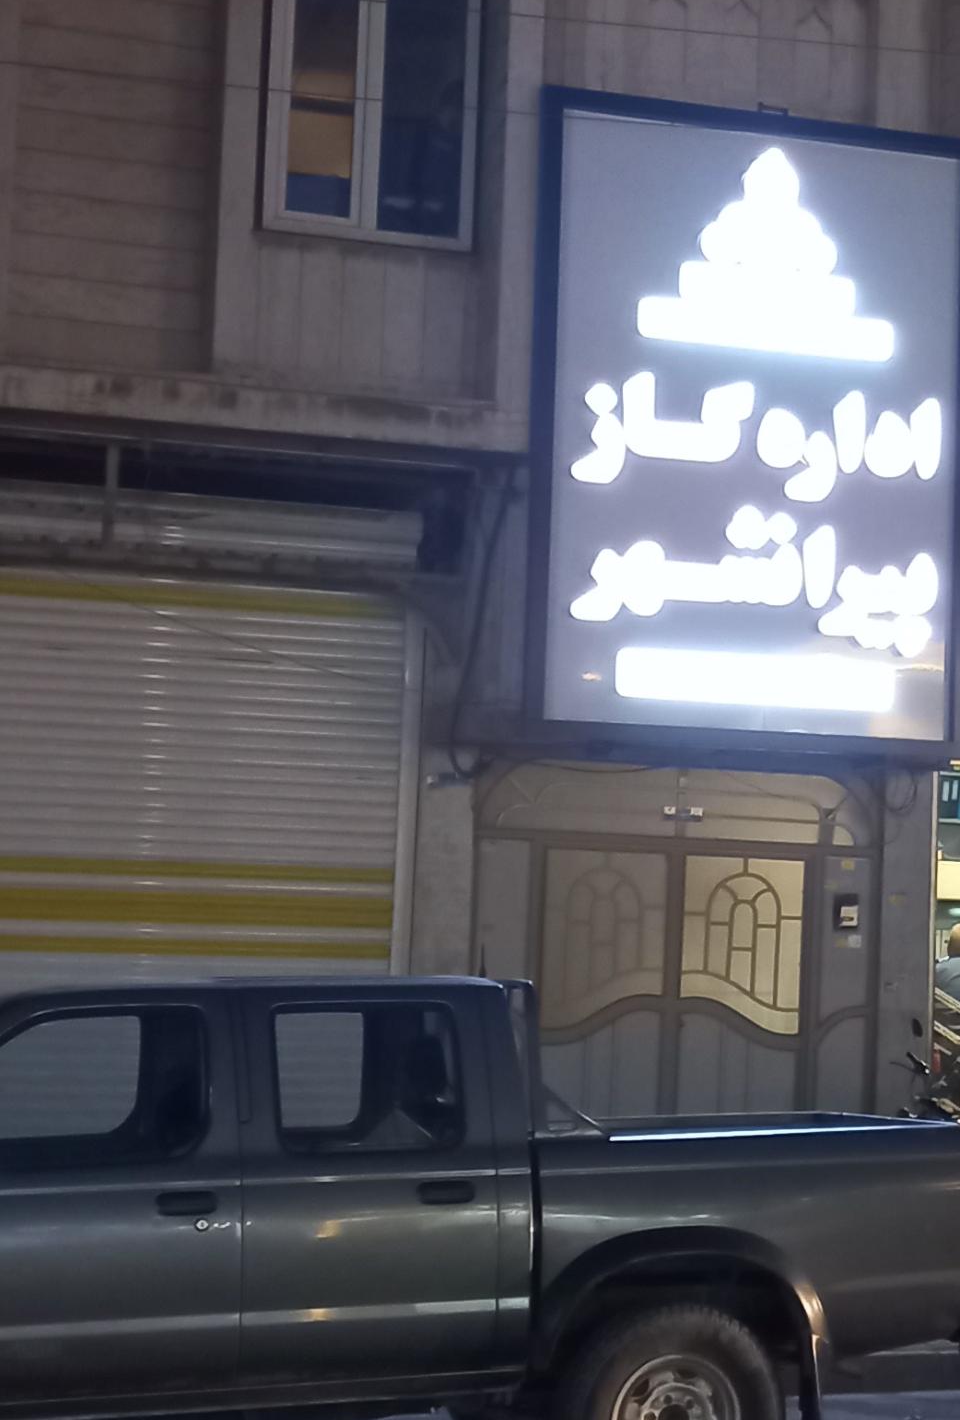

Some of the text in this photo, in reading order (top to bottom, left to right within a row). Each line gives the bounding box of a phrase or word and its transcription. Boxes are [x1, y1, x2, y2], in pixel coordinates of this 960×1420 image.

[570, 371, 943, 503] اداره گاز
[569, 504, 940, 659] پیرانشهر
